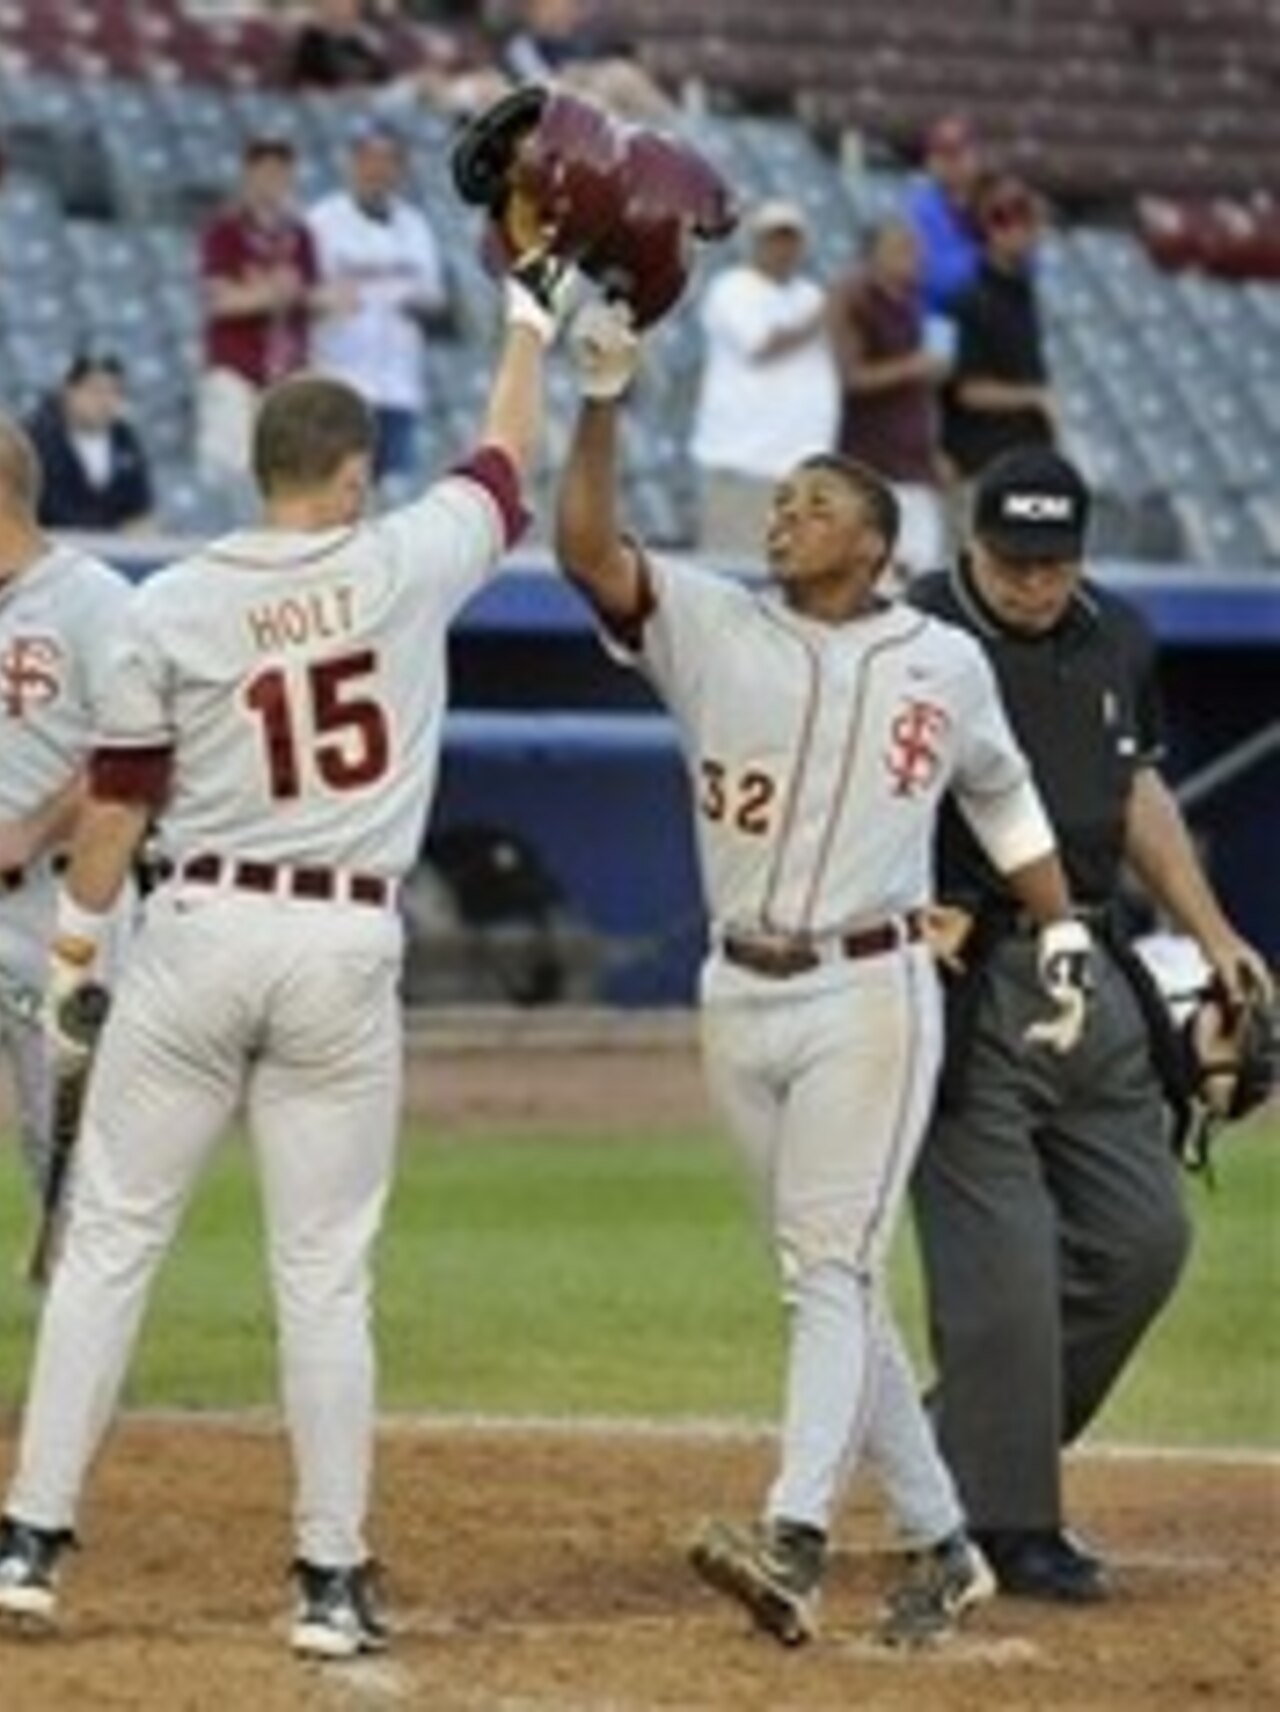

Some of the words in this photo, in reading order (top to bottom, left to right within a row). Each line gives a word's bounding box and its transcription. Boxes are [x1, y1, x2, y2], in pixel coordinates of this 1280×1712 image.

[247, 590, 355, 649] HOLT
[246, 650, 392, 800] 15
[701, 760, 776, 834] 32
